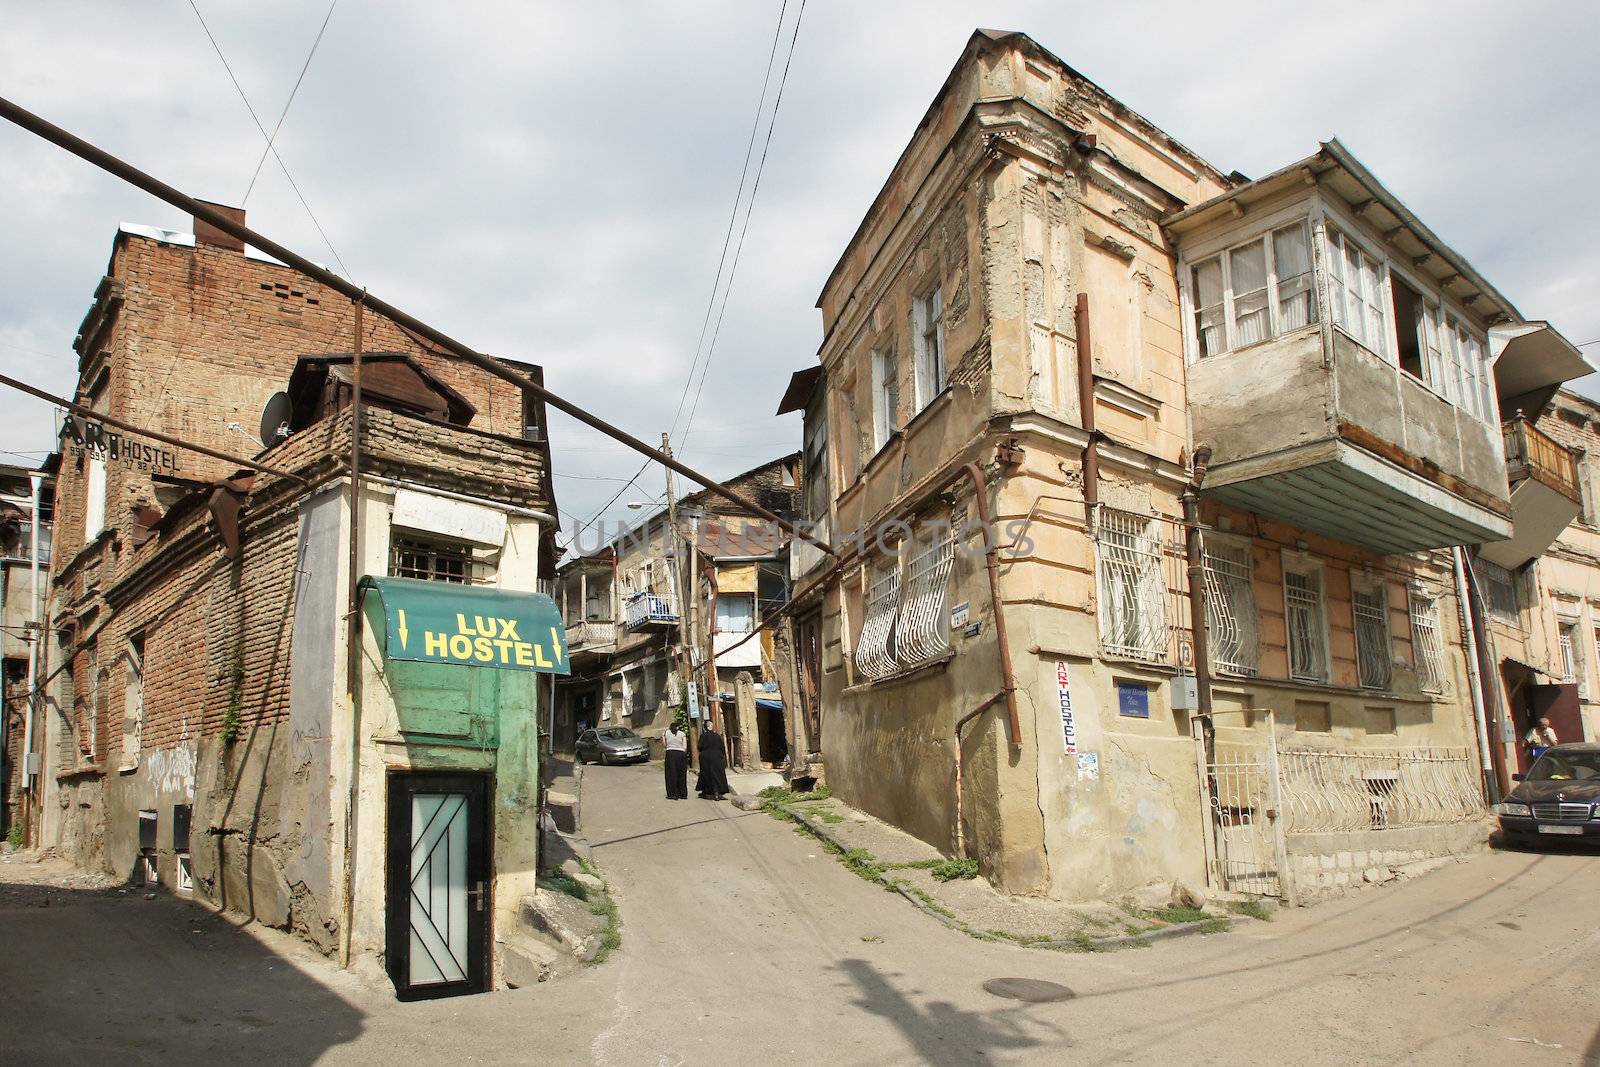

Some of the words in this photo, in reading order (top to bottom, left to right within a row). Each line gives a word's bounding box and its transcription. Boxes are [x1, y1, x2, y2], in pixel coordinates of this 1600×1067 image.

[58, 413, 122, 461] ART
[121, 438, 180, 472] HOSTEL
[456, 613, 521, 641] LUX
[425, 631, 553, 668] HOSTEL
[1057, 661, 1069, 689] ART
[1060, 690, 1075, 746] HOSTEL
